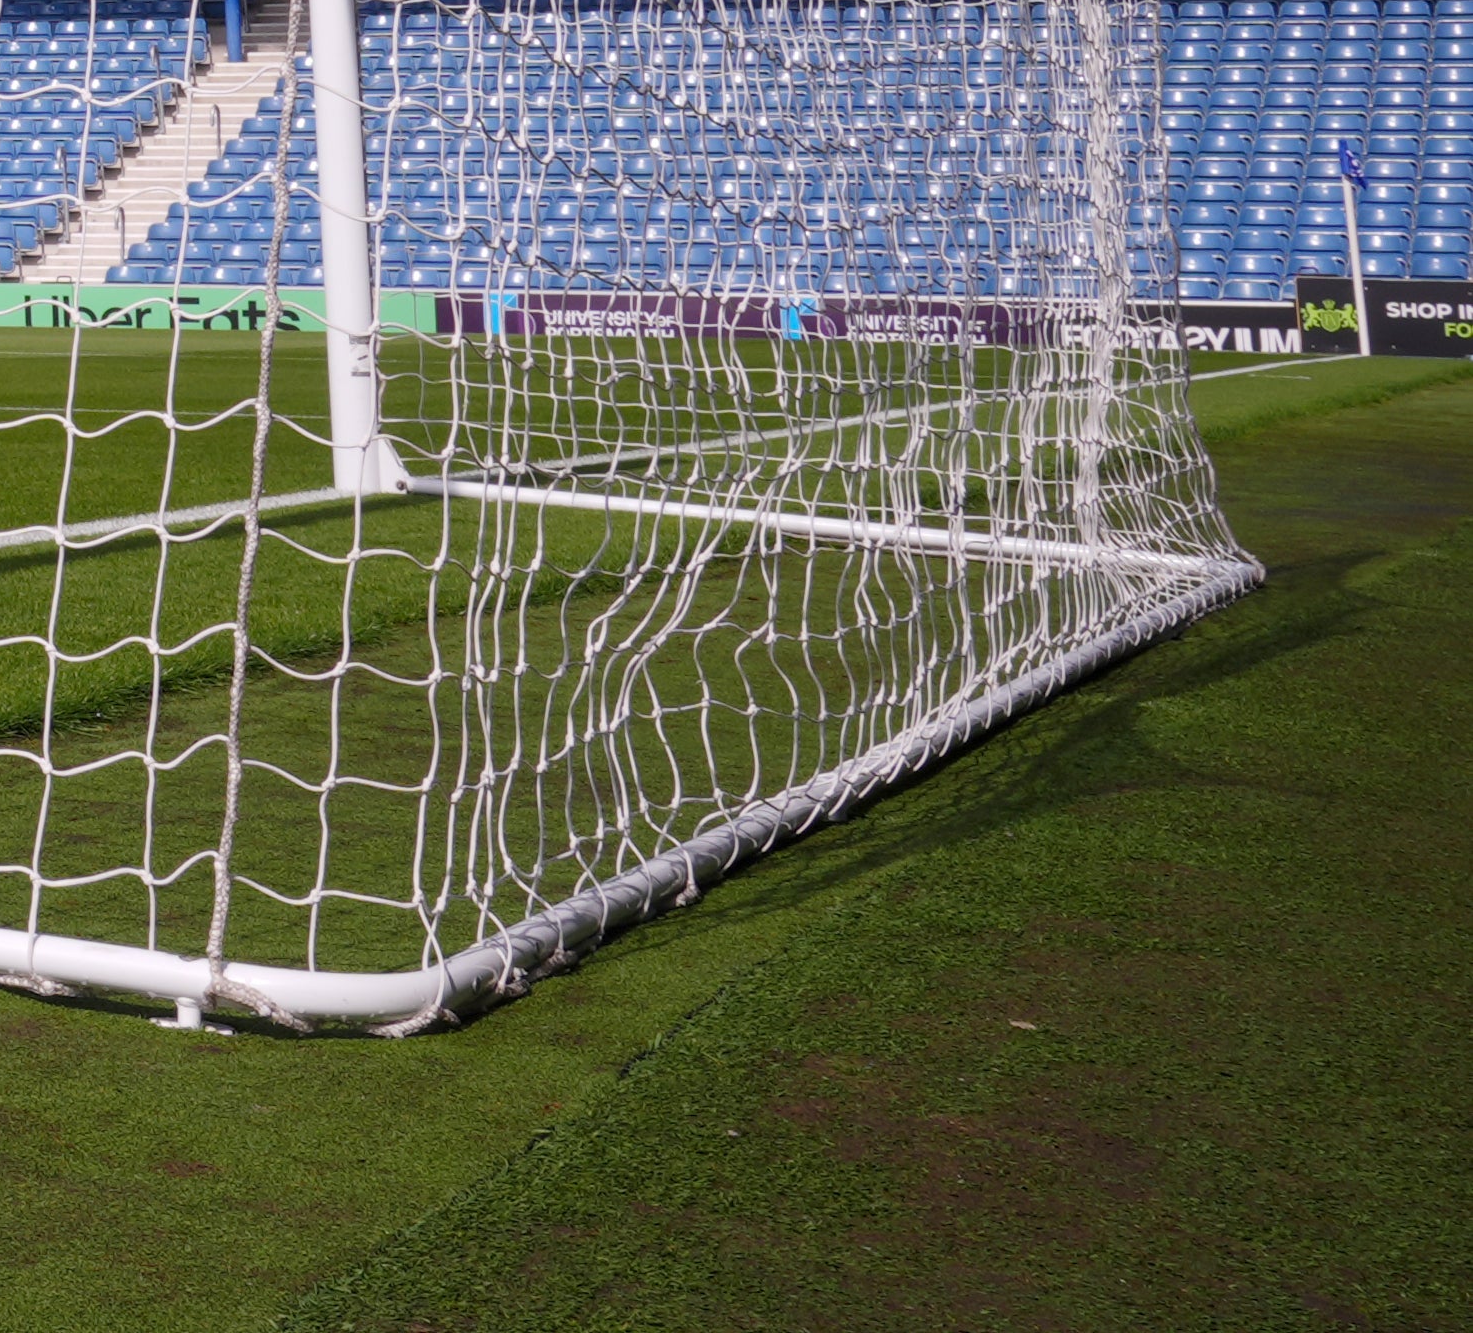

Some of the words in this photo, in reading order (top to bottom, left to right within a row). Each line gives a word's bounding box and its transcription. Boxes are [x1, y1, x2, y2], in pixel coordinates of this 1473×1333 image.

[24, 295, 152, 329] Uber
[169, 297, 301, 332] Eats
[544, 310, 657, 326] UNIVERSITY
[1385, 301, 1453, 320] SHOP
